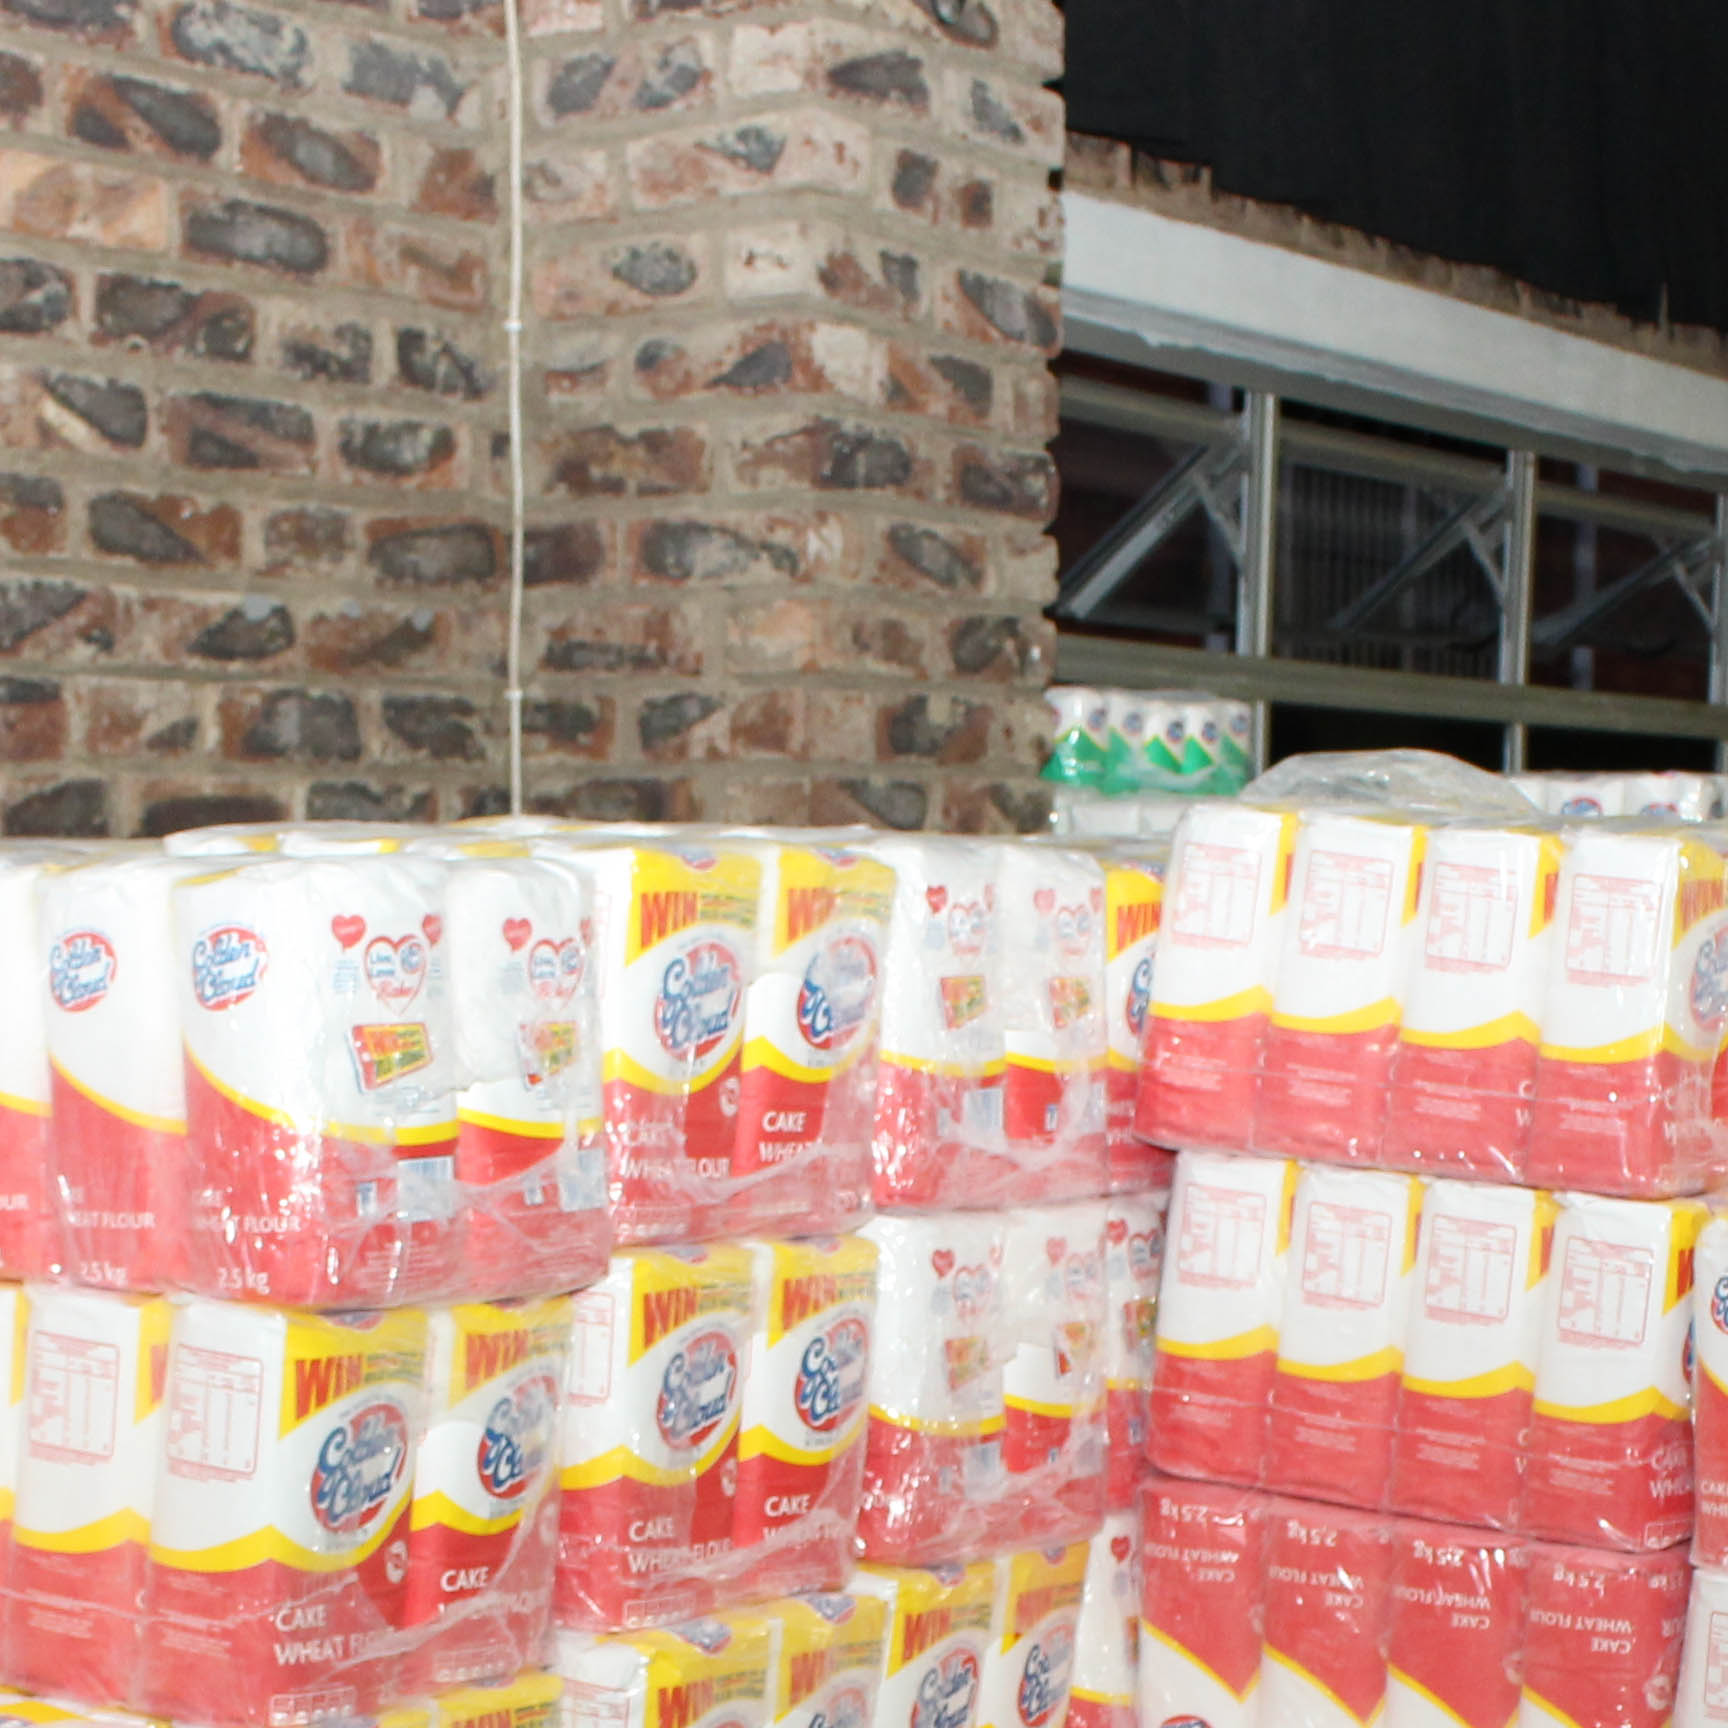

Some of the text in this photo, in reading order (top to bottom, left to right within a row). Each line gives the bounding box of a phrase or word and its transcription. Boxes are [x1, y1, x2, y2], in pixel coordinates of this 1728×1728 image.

[640, 891, 698, 951] WIN
[763, 1111, 807, 1133] CAKE
[643, 1285, 698, 1349] WIN
[464, 1329, 529, 1391] WIN
[295, 1354, 363, 1421] WIN
[764, 1494, 810, 1517] CAKE
[440, 1567, 490, 1592] CAKE
[1197, 1567, 1236, 1583] CAKE
[273, 1603, 327, 1632] CAKE
[1451, 1612, 1490, 1629] CAKE
[1575, 1612, 1634, 1634] WHEAT
[274, 1637, 345, 1665] WHEAT
[1590, 1637, 1634, 1654] CAKE
